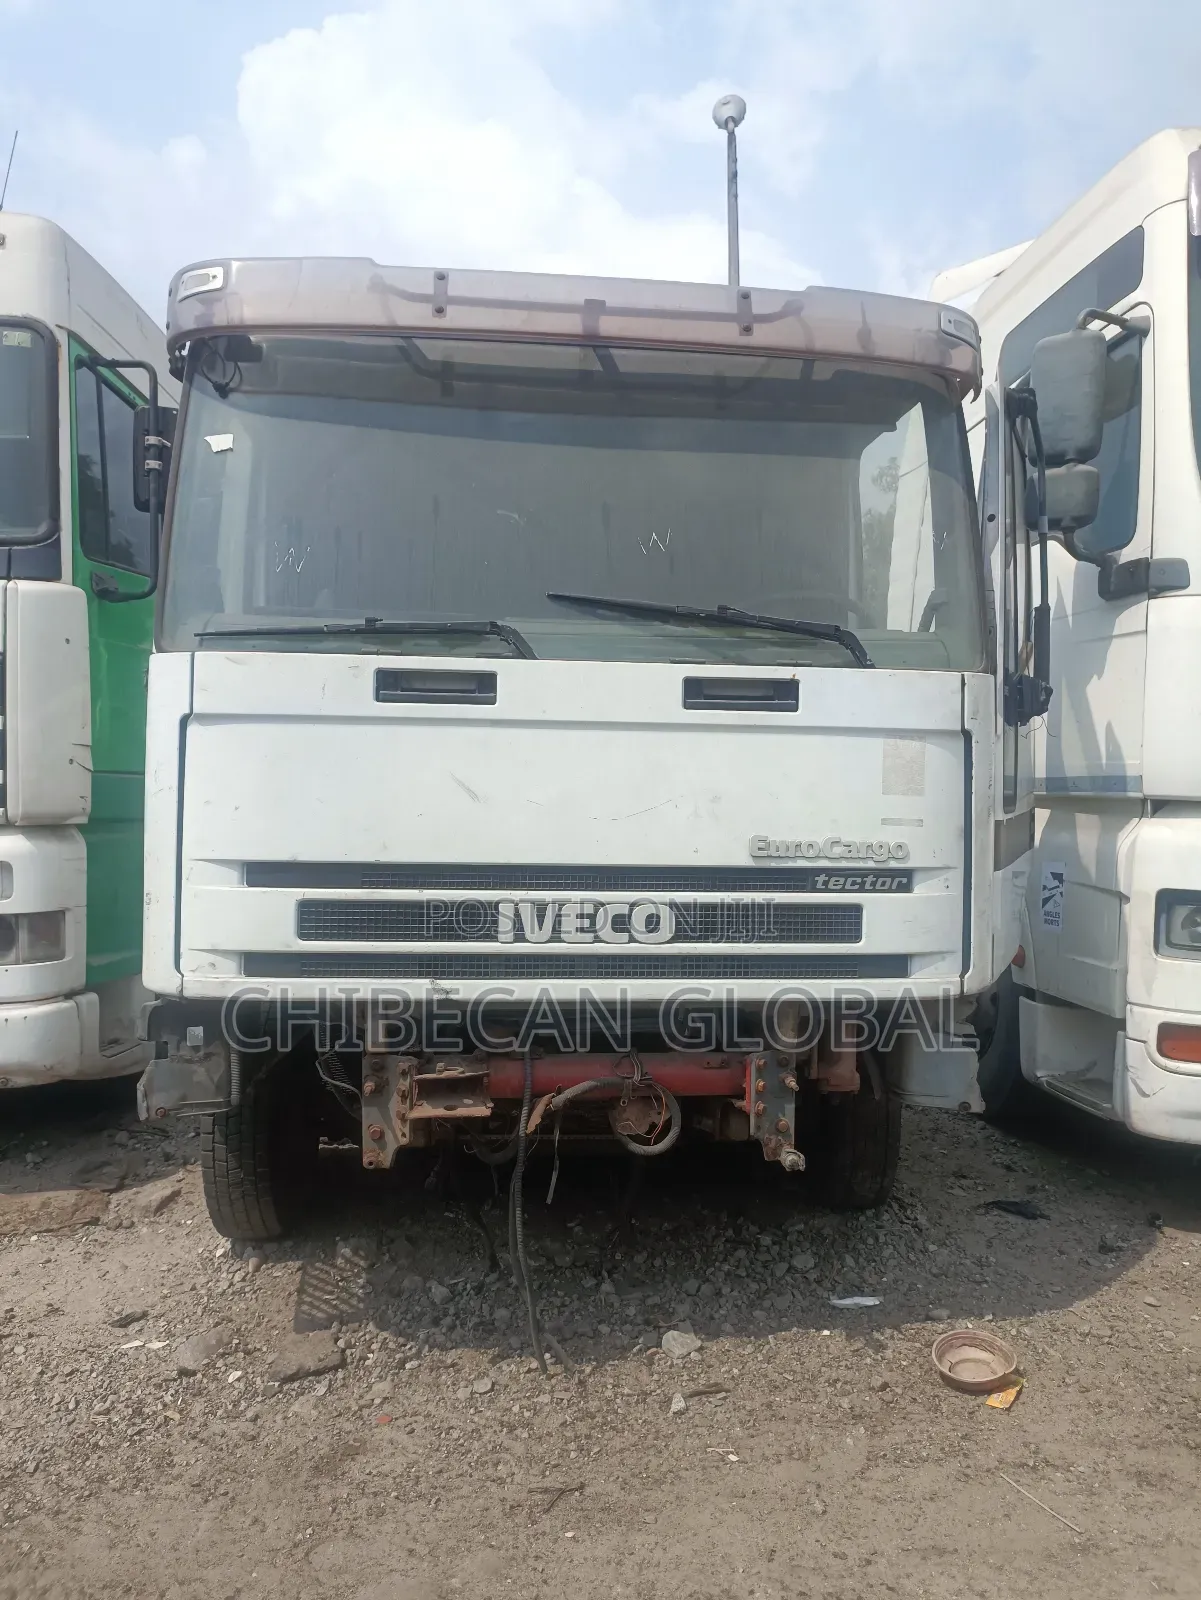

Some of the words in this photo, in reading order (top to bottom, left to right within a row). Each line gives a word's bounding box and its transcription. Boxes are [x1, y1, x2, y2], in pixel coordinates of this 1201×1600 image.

[750, 834, 909, 861] EuroCargo
[814, 873, 907, 890] tector
[498, 903, 675, 943] IVECO
[1044, 910, 1060, 919] ANGLES
